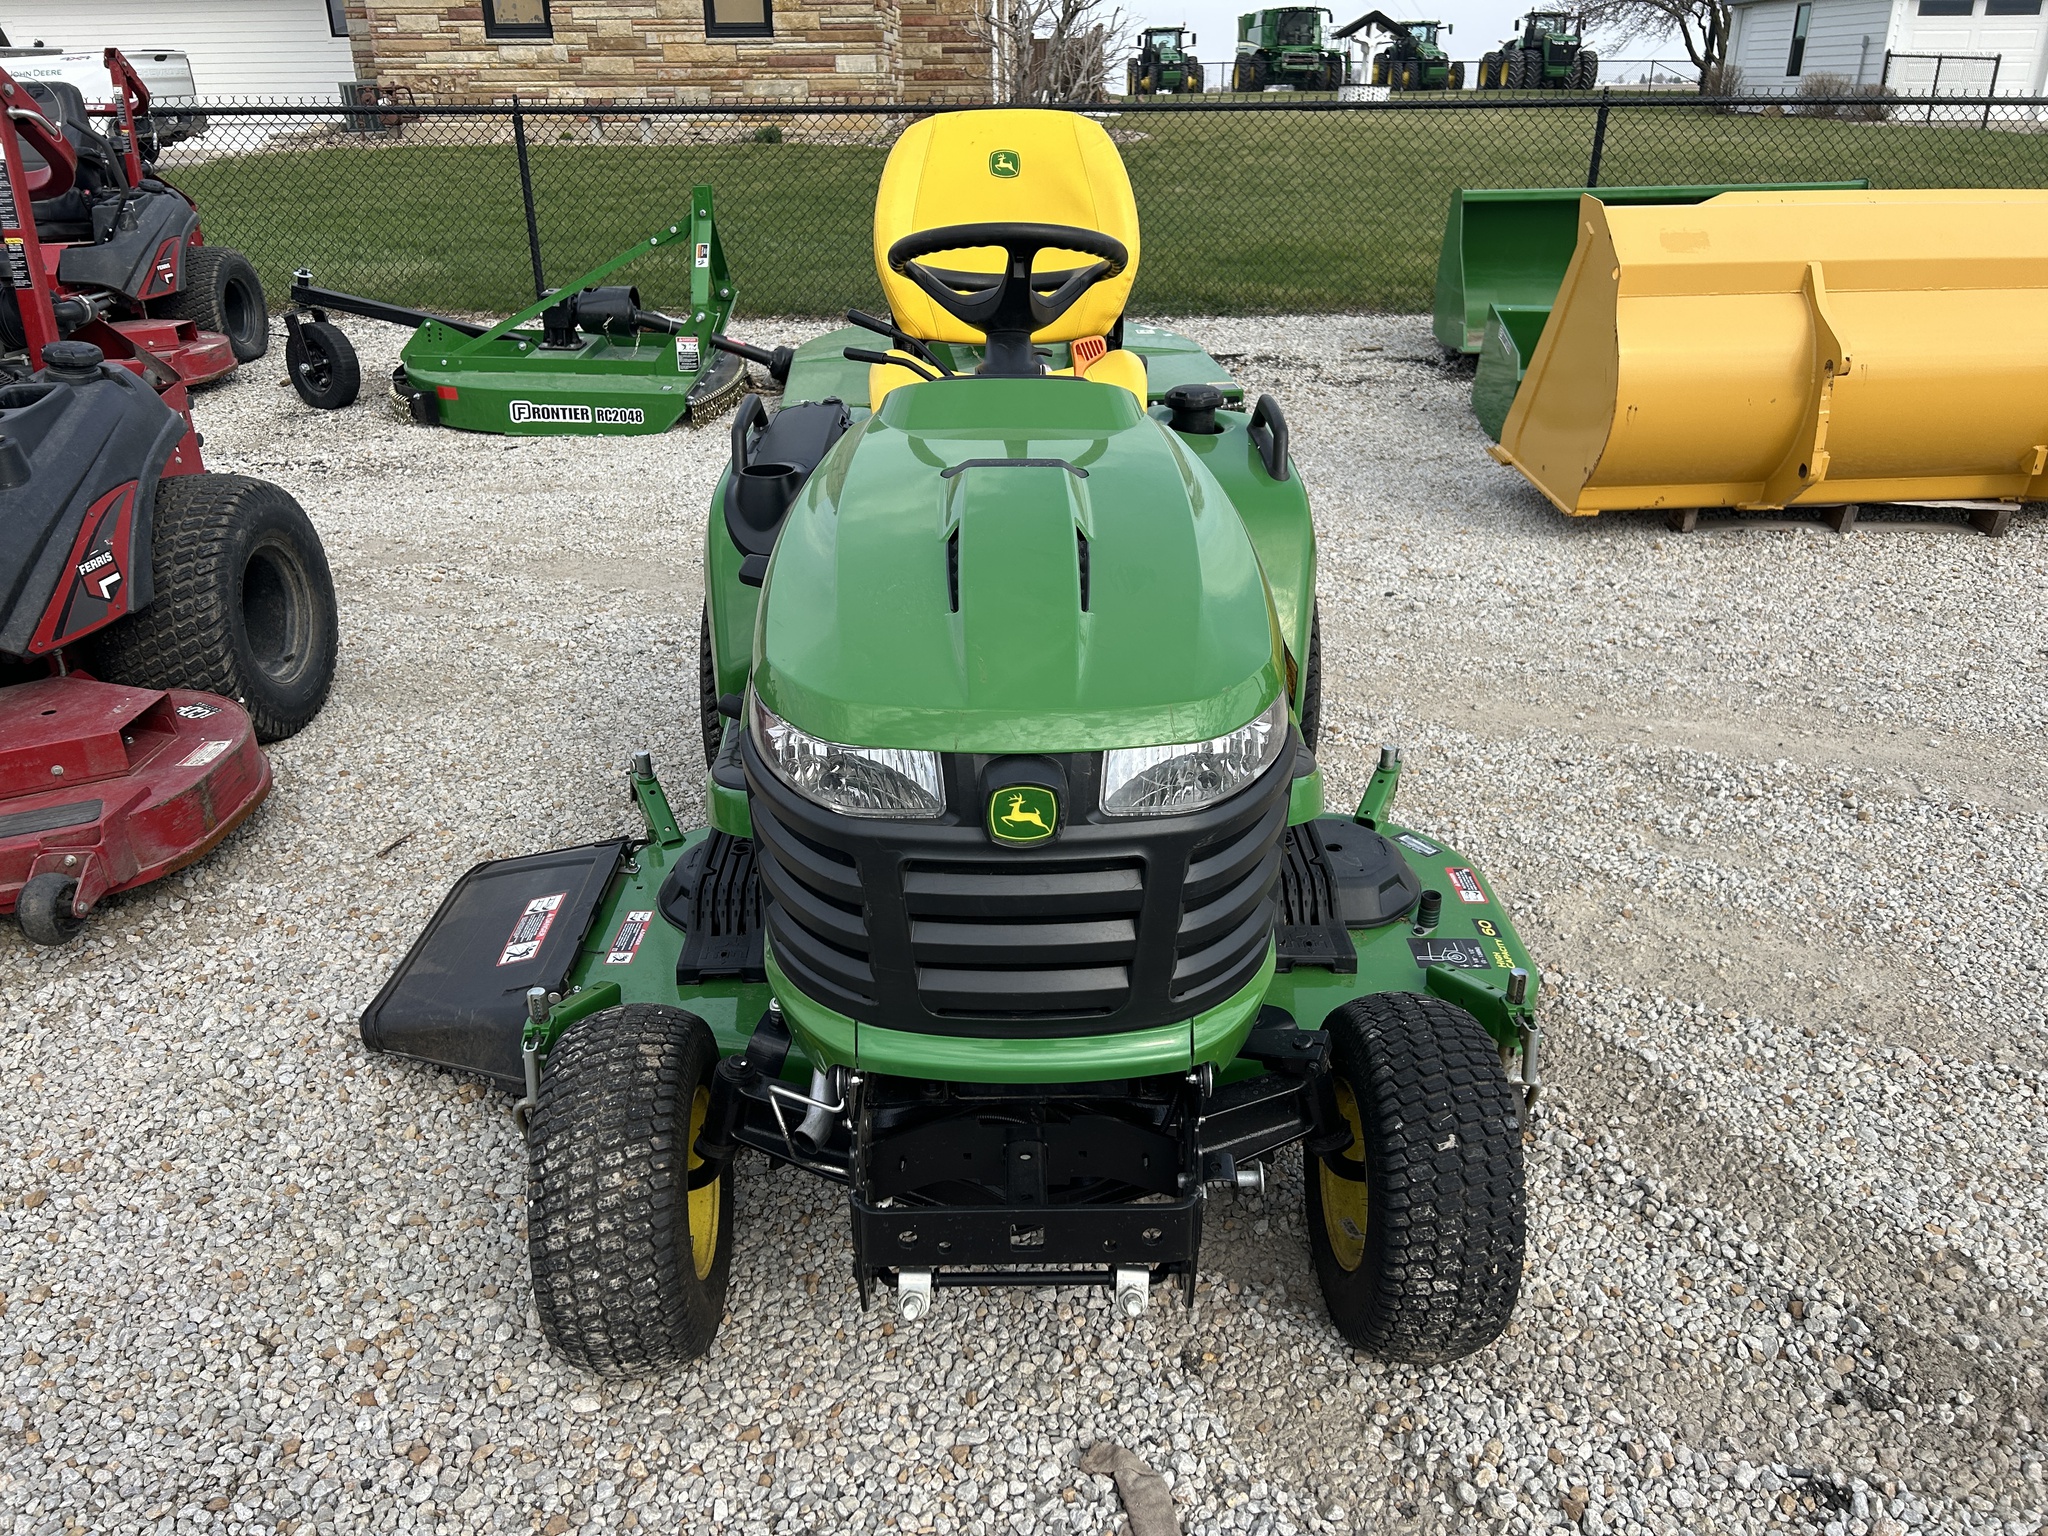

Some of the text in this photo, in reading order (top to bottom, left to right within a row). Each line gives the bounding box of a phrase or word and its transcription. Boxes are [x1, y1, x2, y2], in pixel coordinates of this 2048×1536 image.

[33, 69, 63, 77] DEERE
[513, 403, 643, 423] FRONTIER RC2048
[78, 551, 113, 576] FERRIS
[1477, 920, 1496, 936] 60
[1492, 951, 1507, 968] HIGH
[1494, 938, 1516, 968] CAPACITY
